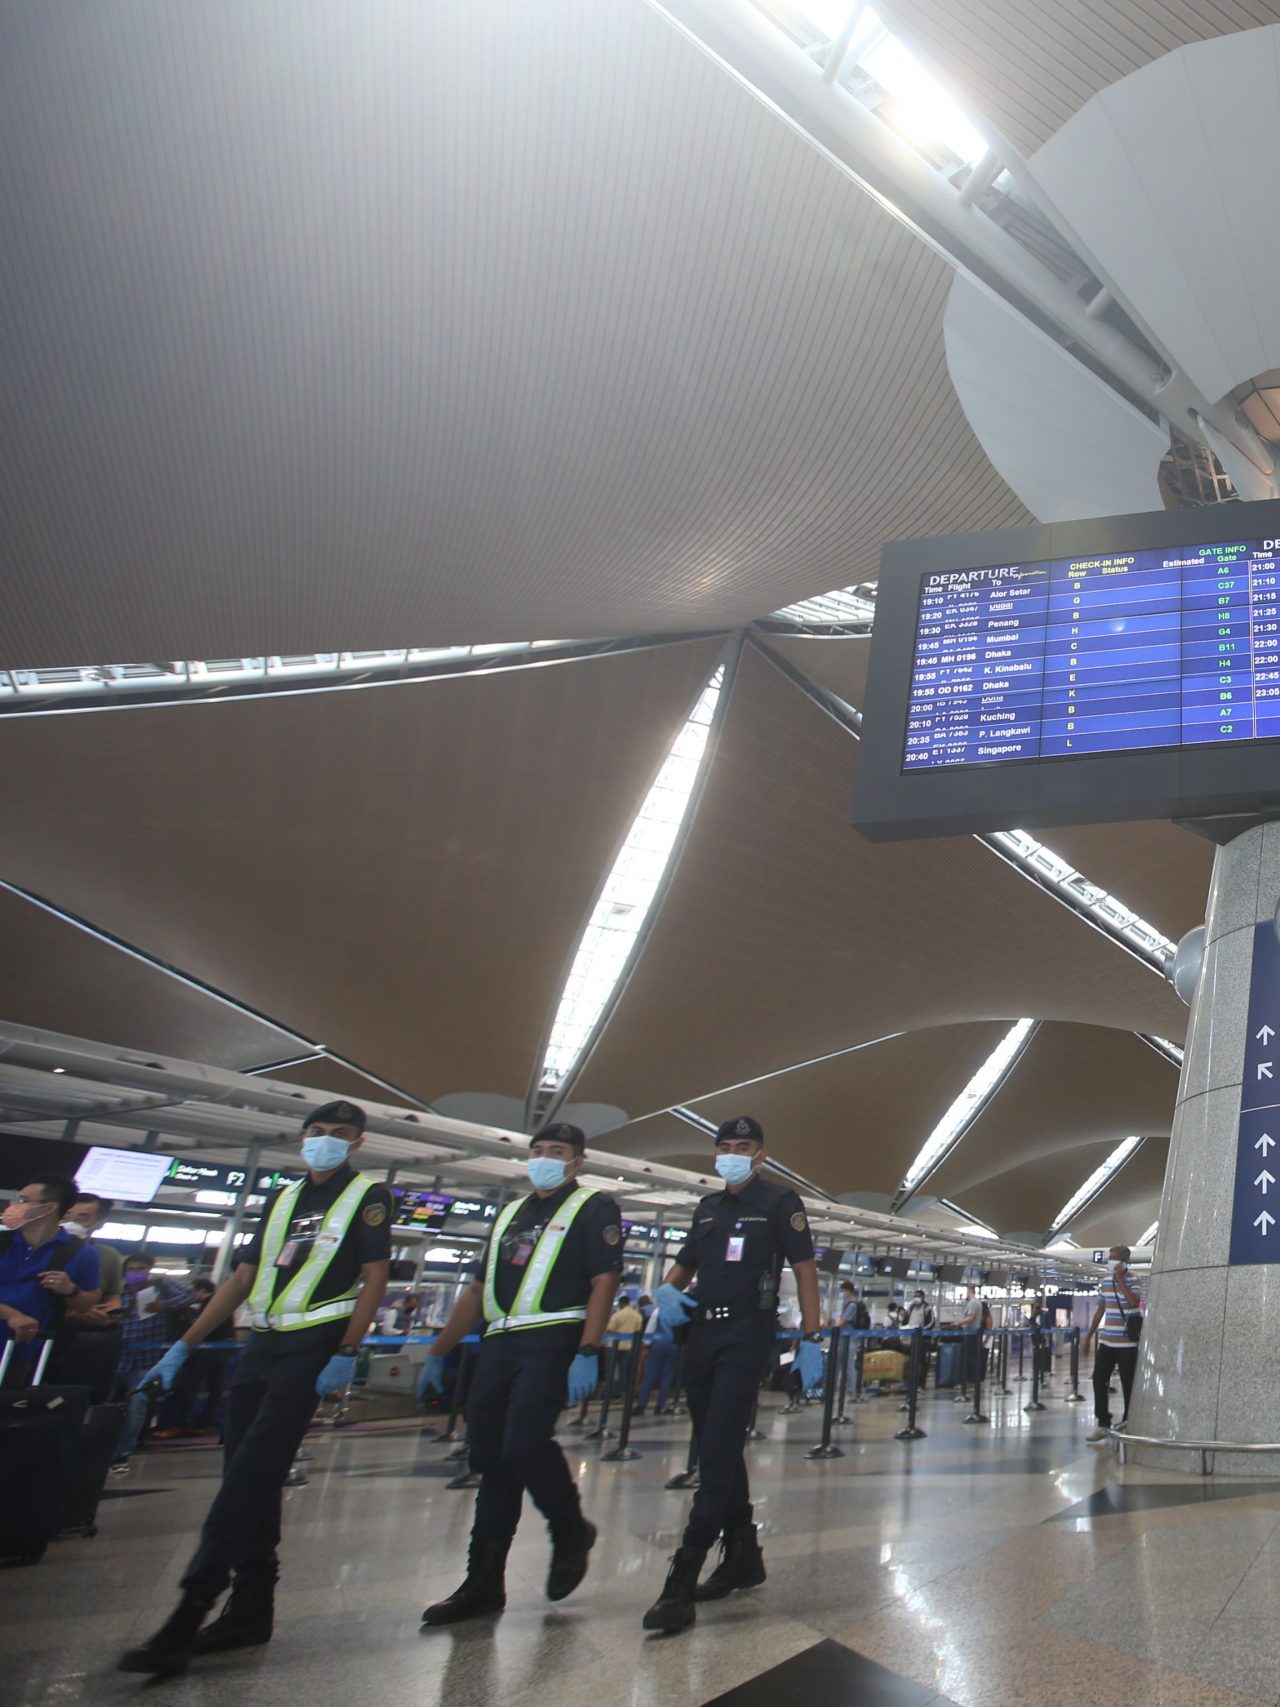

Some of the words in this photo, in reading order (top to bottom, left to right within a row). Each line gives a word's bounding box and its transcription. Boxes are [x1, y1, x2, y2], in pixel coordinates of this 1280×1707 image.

[1199, 548, 1222, 556] GATE
[1224, 545, 1246, 554] INFO
[1253, 551, 1273, 559] Time
[1163, 557, 1205, 568] Estimated
[1217, 554, 1237, 562] Gate
[1069, 558, 1113, 570] CHECK-IN
[1113, 557, 1135, 566] INFO
[1252, 563, 1275, 571] 21:00
[929, 567, 1019, 585] DEPARTURE
[1068, 570, 1086, 578] Row
[1102, 566, 1128, 575] Status
[1253, 578, 1276, 586] 21:10
[948, 583, 971, 592] Flight
[922, 598, 944, 606] 19:10
[990, 590, 1007, 599] Alor
[1009, 588, 1031, 596] Setar
[1253, 593, 1276, 601] 21:15
[921, 612, 943, 620] 19:20
[1253, 608, 1277, 617] 21:25
[917, 642, 940, 651] 19:45
[986, 634, 1019, 643] Mumbai
[1218, 612, 1230, 620] H8
[920, 627, 941, 635] 19:30
[988, 619, 1019, 629] Penang
[1253, 624, 1277, 632] 21:30
[1254, 640, 1278, 648] 22:00
[914, 672, 936, 681] 19:55
[995, 663, 1032, 673] Kinabalu
[1218, 643, 1235, 651] B11
[916, 657, 938, 666] 19:45
[941, 655, 954, 663] MH
[957, 653, 977, 661] 0196
[985, 650, 1012, 659] Dhaka
[1254, 656, 1278, 664] 22:00
[912, 688, 935, 697] 19:55
[938, 686, 951, 694] OD
[953, 684, 974, 693] 0162
[983, 681, 1009, 690] Dhaka
[1219, 659, 1231, 667] H4
[1255, 672, 1279, 680] 22:45
[1256, 688, 1280, 697] 23:05
[909, 720, 932, 729] 20:10
[980, 712, 1016, 722] Kuching
[1220, 692, 1232, 700] B6
[910, 704, 933, 713] 20:00
[907, 736, 930, 745] 20:35
[990, 727, 1031, 738] Langkawi
[1067, 722, 1074, 730] B
[1220, 708, 1232, 716] A7
[905, 752, 929, 762] 20:40
[978, 744, 1022, 756] Singapore
[1067, 739, 1072, 747] L
[1220, 725, 1233, 733] C2
[226, 1171, 245, 1187] F2
[1094, 1252, 1102, 1262] F
